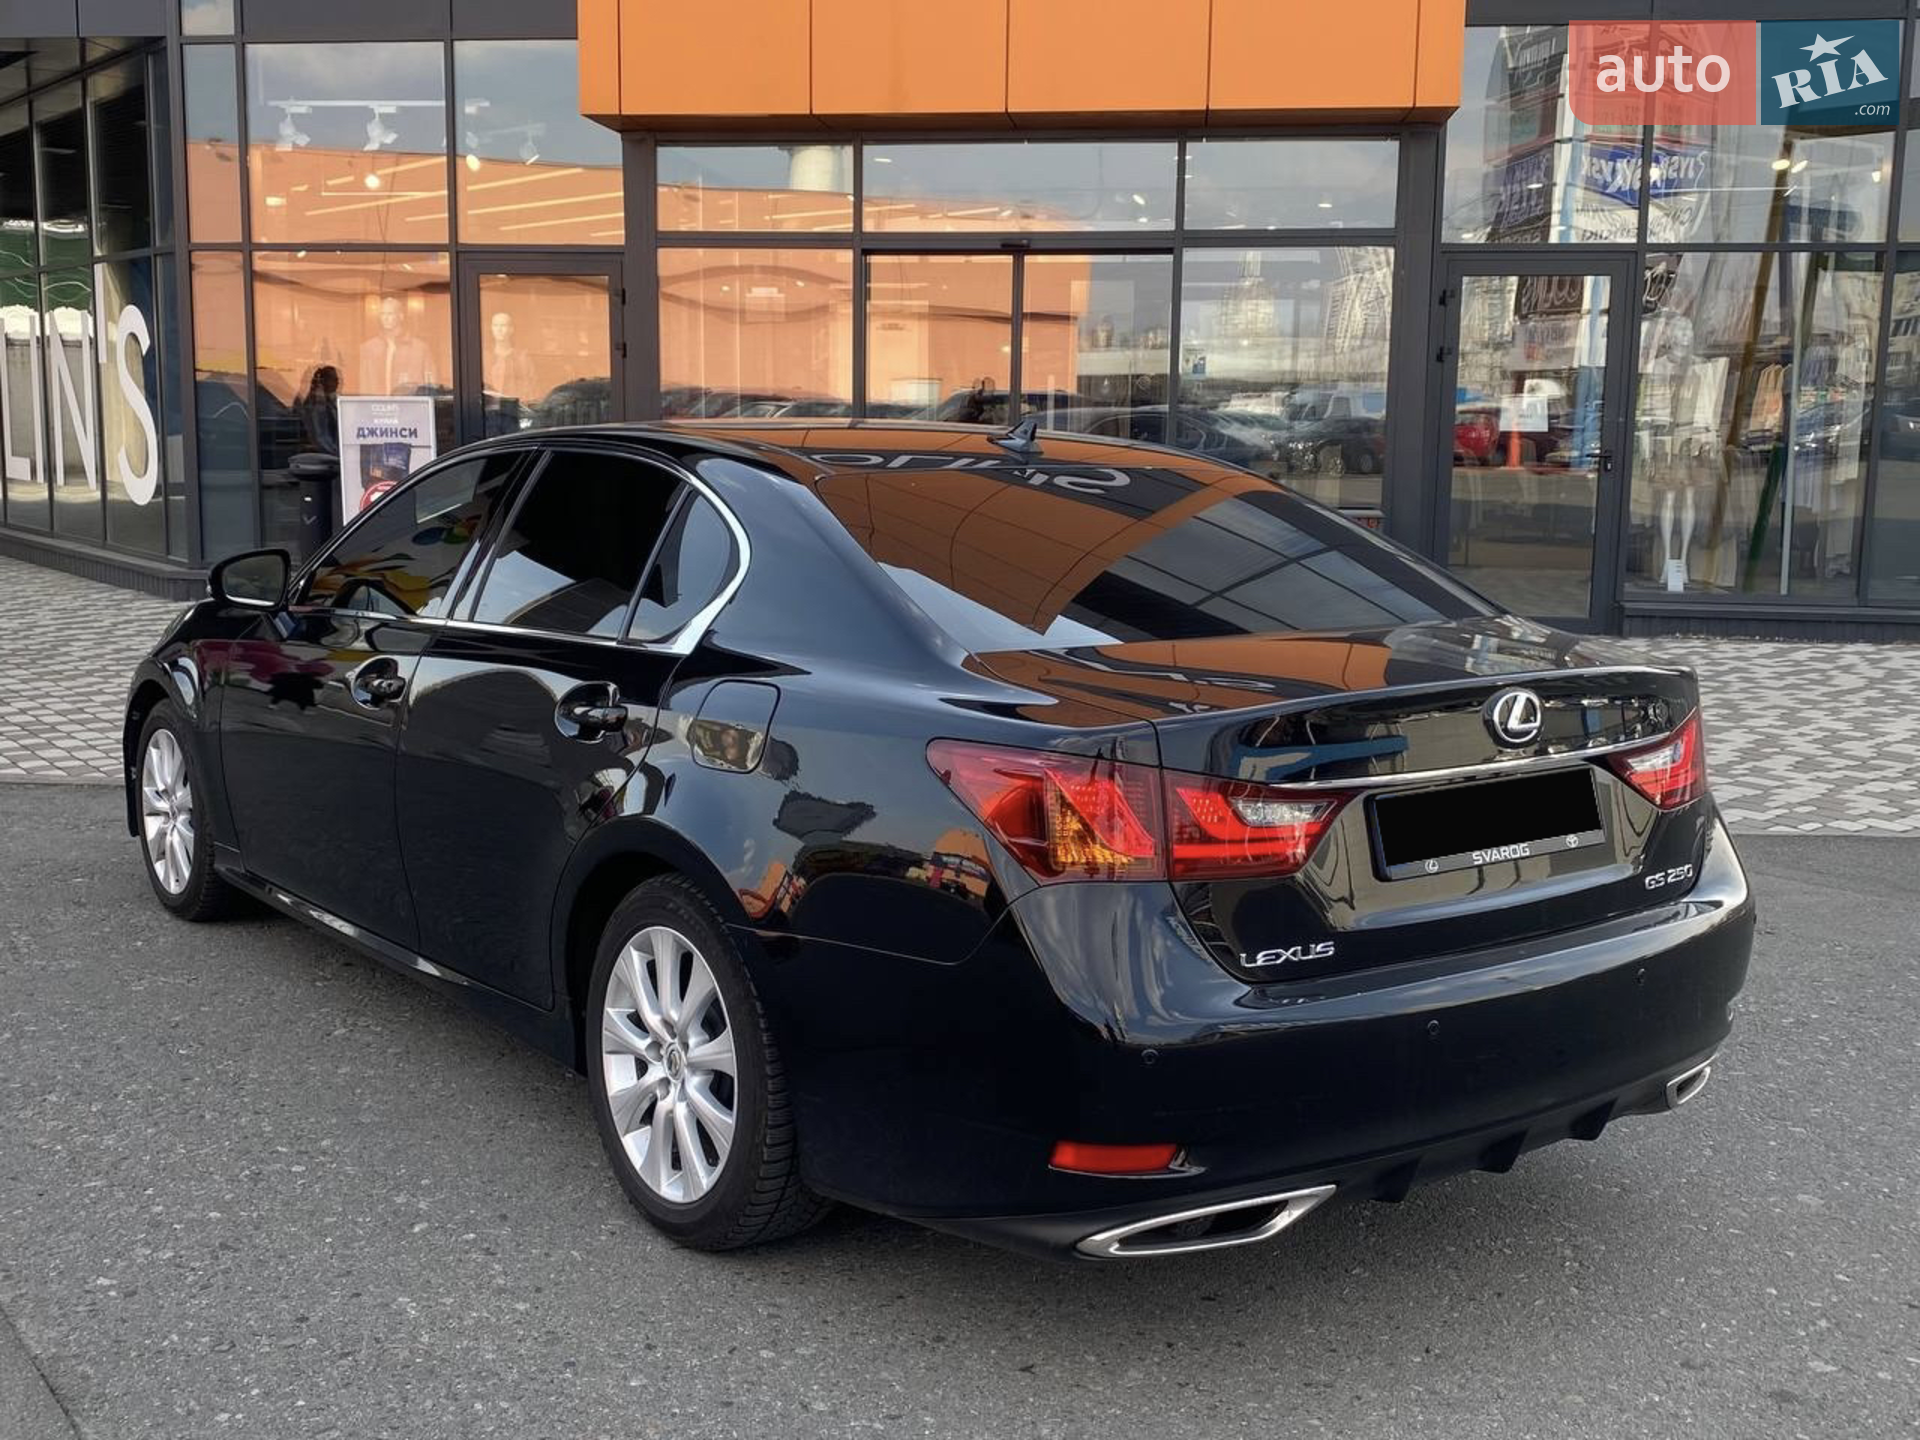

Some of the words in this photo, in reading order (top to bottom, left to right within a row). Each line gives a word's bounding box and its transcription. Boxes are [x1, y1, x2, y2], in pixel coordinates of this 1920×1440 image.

[356, 426, 418, 439] ДЖИНСИ
[1472, 843, 1531, 865] SVAROG
[1644, 873, 1667, 891] GS
[1667, 863, 1693, 882] 250
[1239, 941, 1336, 968] LEXUS
